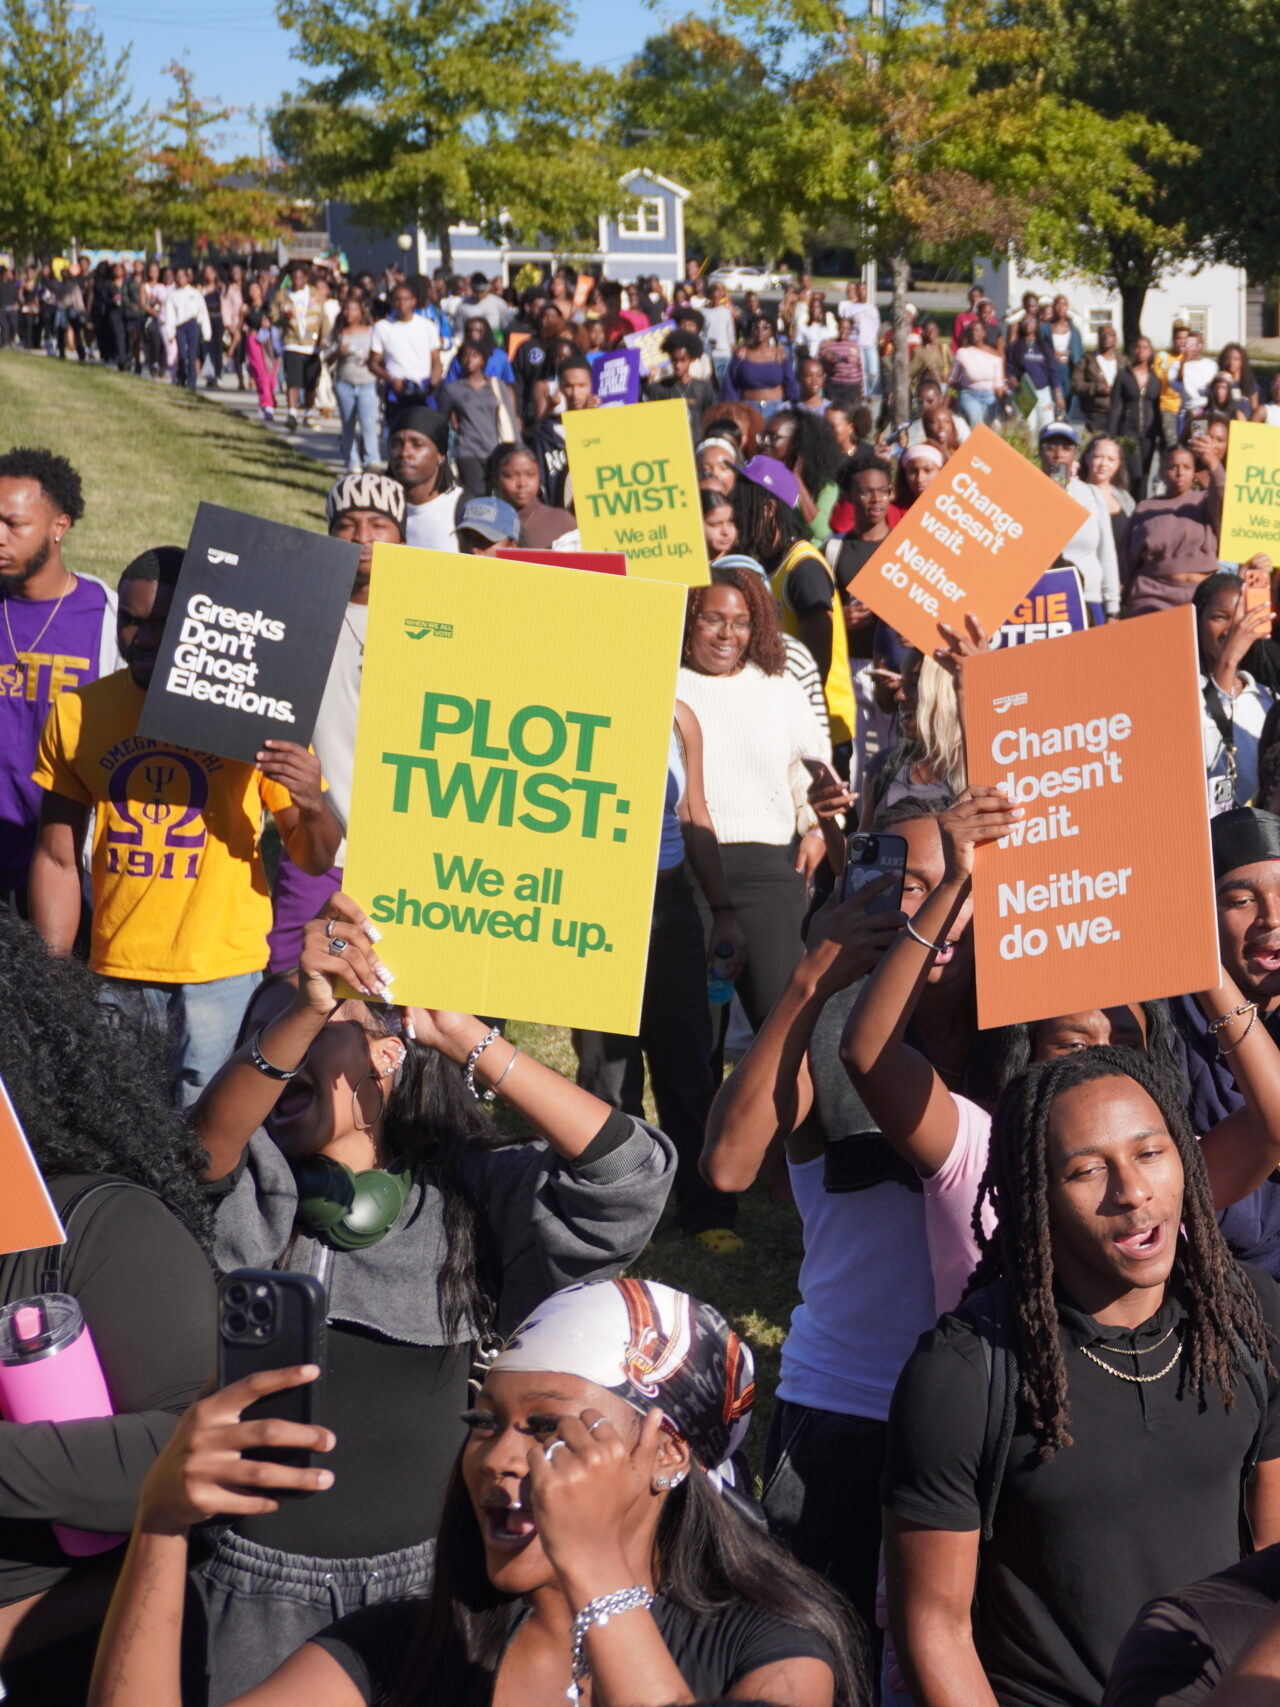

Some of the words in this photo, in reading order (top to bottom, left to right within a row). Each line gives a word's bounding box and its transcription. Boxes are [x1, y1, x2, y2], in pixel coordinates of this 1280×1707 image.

[596, 458, 670, 491] PLOT
[585, 484, 687, 518] TWIST:
[934, 493, 1005, 556] doesn't
[950, 471, 1024, 540] Change
[1249, 514, 1270, 528] We
[614, 527, 644, 545] We
[648, 524, 667, 541] all
[667, 541, 693, 559] up.
[919, 510, 966, 557] wait.
[1231, 525, 1280, 541] showed
[880, 560, 909, 589] do
[905, 581, 940, 618] we.
[894, 538, 967, 604] Neither
[179, 617, 256, 660] Don't
[187, 593, 286, 642] Greeks
[173, 643, 260, 687] Ghost
[165, 667, 296, 724] Elections.
[98, 735, 158, 771] OMEGA
[419, 690, 612, 773] PLOT
[991, 712, 1132, 766] Change
[381, 752, 632, 843] TWIST:
[107, 848, 200, 879] 1911
[432, 851, 505, 897] We
[513, 867, 564, 906] all
[998, 867, 1132, 918] Neither
[369, 888, 541, 943] showed
[551, 918, 614, 959] up.
[999, 923, 1049, 961] do
[1056, 915, 1121, 951] we.
